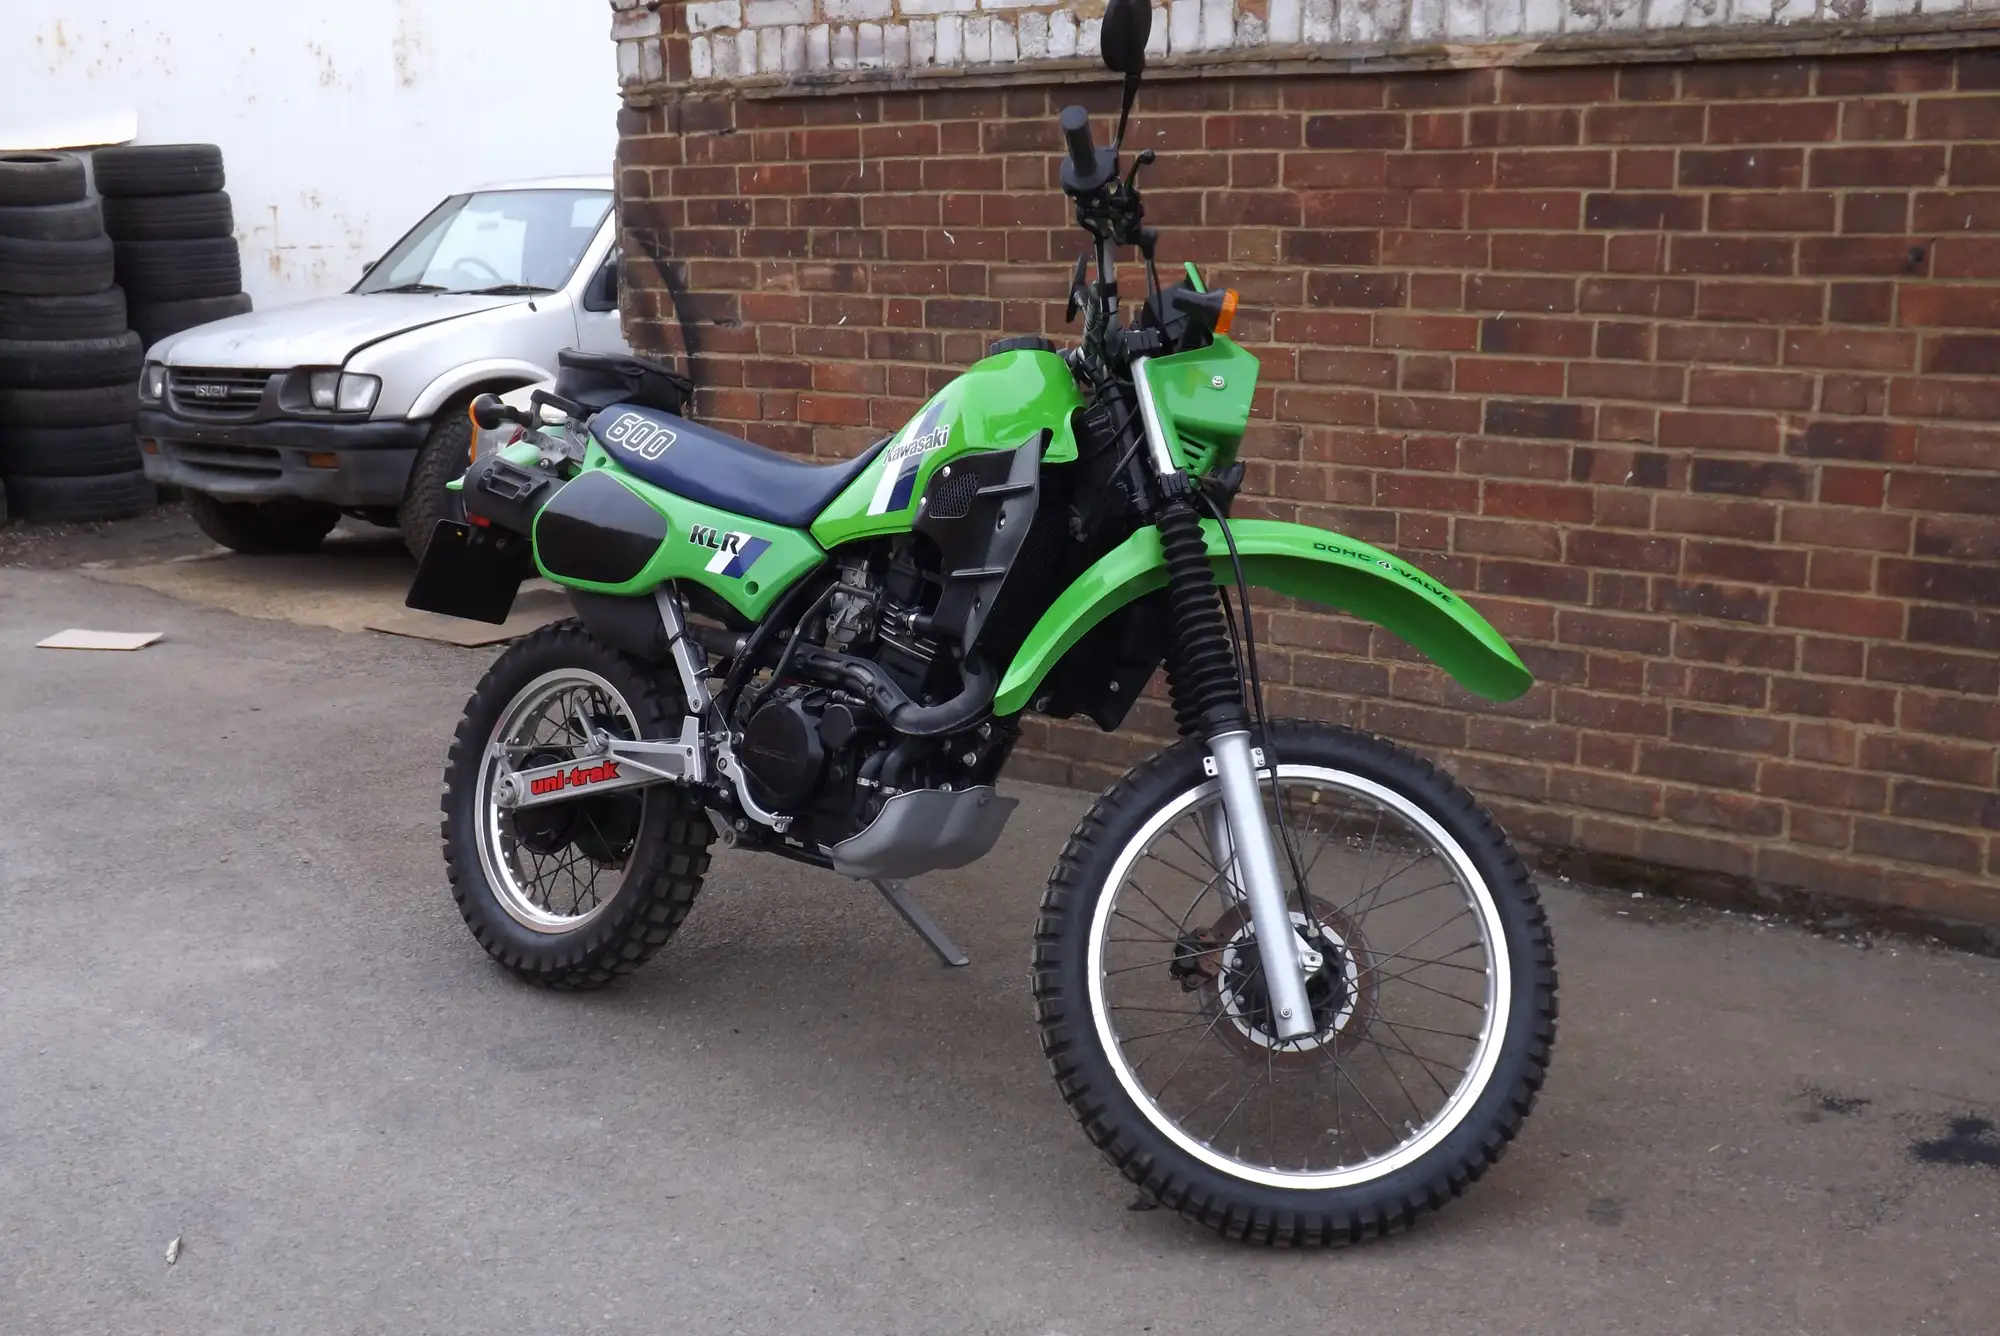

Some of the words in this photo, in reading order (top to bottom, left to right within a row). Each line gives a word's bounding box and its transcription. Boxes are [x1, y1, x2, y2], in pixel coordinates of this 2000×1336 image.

[195, 385, 228, 396] ISUZU
[606, 412, 676, 460] 600
[883, 424, 949, 465] Kawasaki
[688, 524, 741, 556] KLR
[1313, 542, 1371, 562] DOHC
